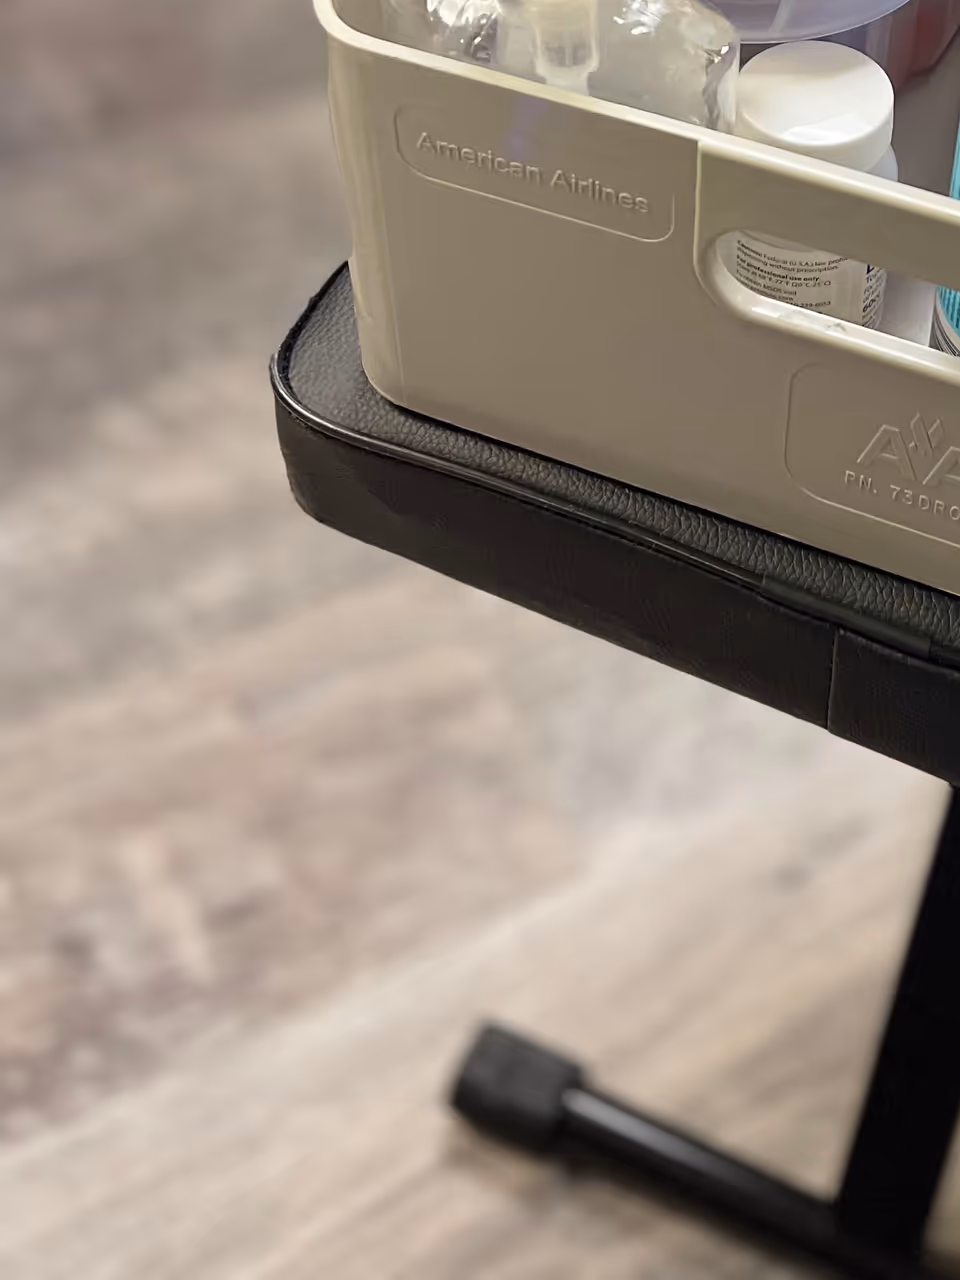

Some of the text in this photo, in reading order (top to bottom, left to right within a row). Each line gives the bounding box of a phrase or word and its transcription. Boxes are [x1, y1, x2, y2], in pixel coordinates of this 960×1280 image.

[416, 131, 649, 213] American Airlines
[746, 261, 788, 280] professional
[769, 262, 795, 273] without
